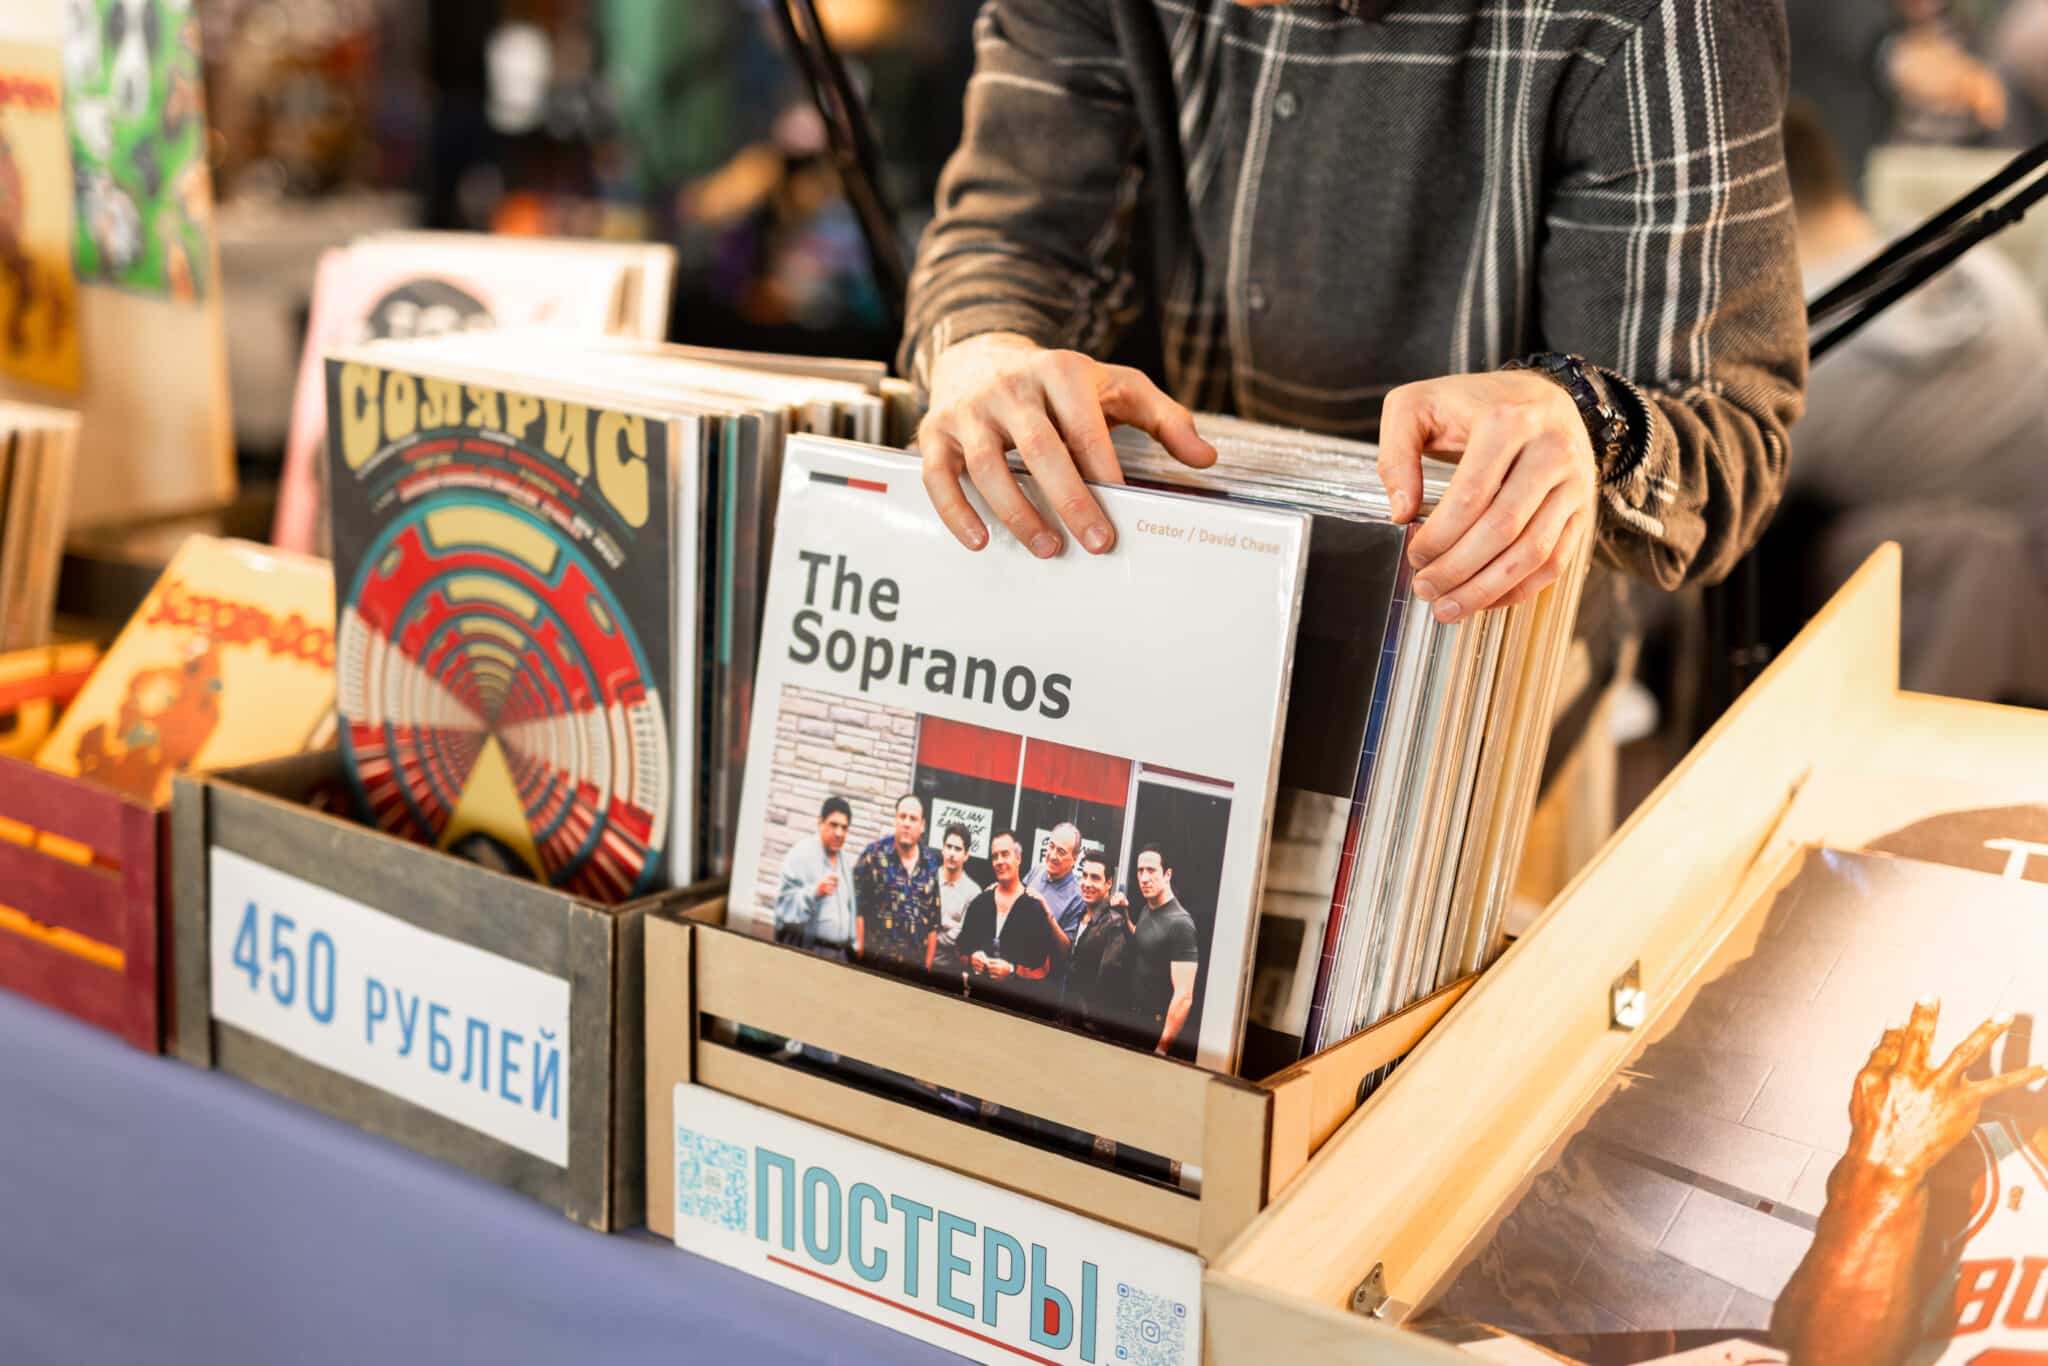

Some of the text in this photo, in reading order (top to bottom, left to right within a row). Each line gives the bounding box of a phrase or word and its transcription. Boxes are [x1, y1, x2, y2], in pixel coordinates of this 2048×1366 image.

[1136, 519, 1185, 538] Creator
[1199, 528, 1237, 548] David
[1239, 536, 1281, 555] Chase
[798, 550, 900, 622] The
[788, 609, 1072, 720] Sopranos
[942, 806, 985, 823] ITALIAN
[233, 901, 560, 1120] 450 РУБЛЕЙ
[755, 1146, 1098, 1365] ПОСТЕРЫ
